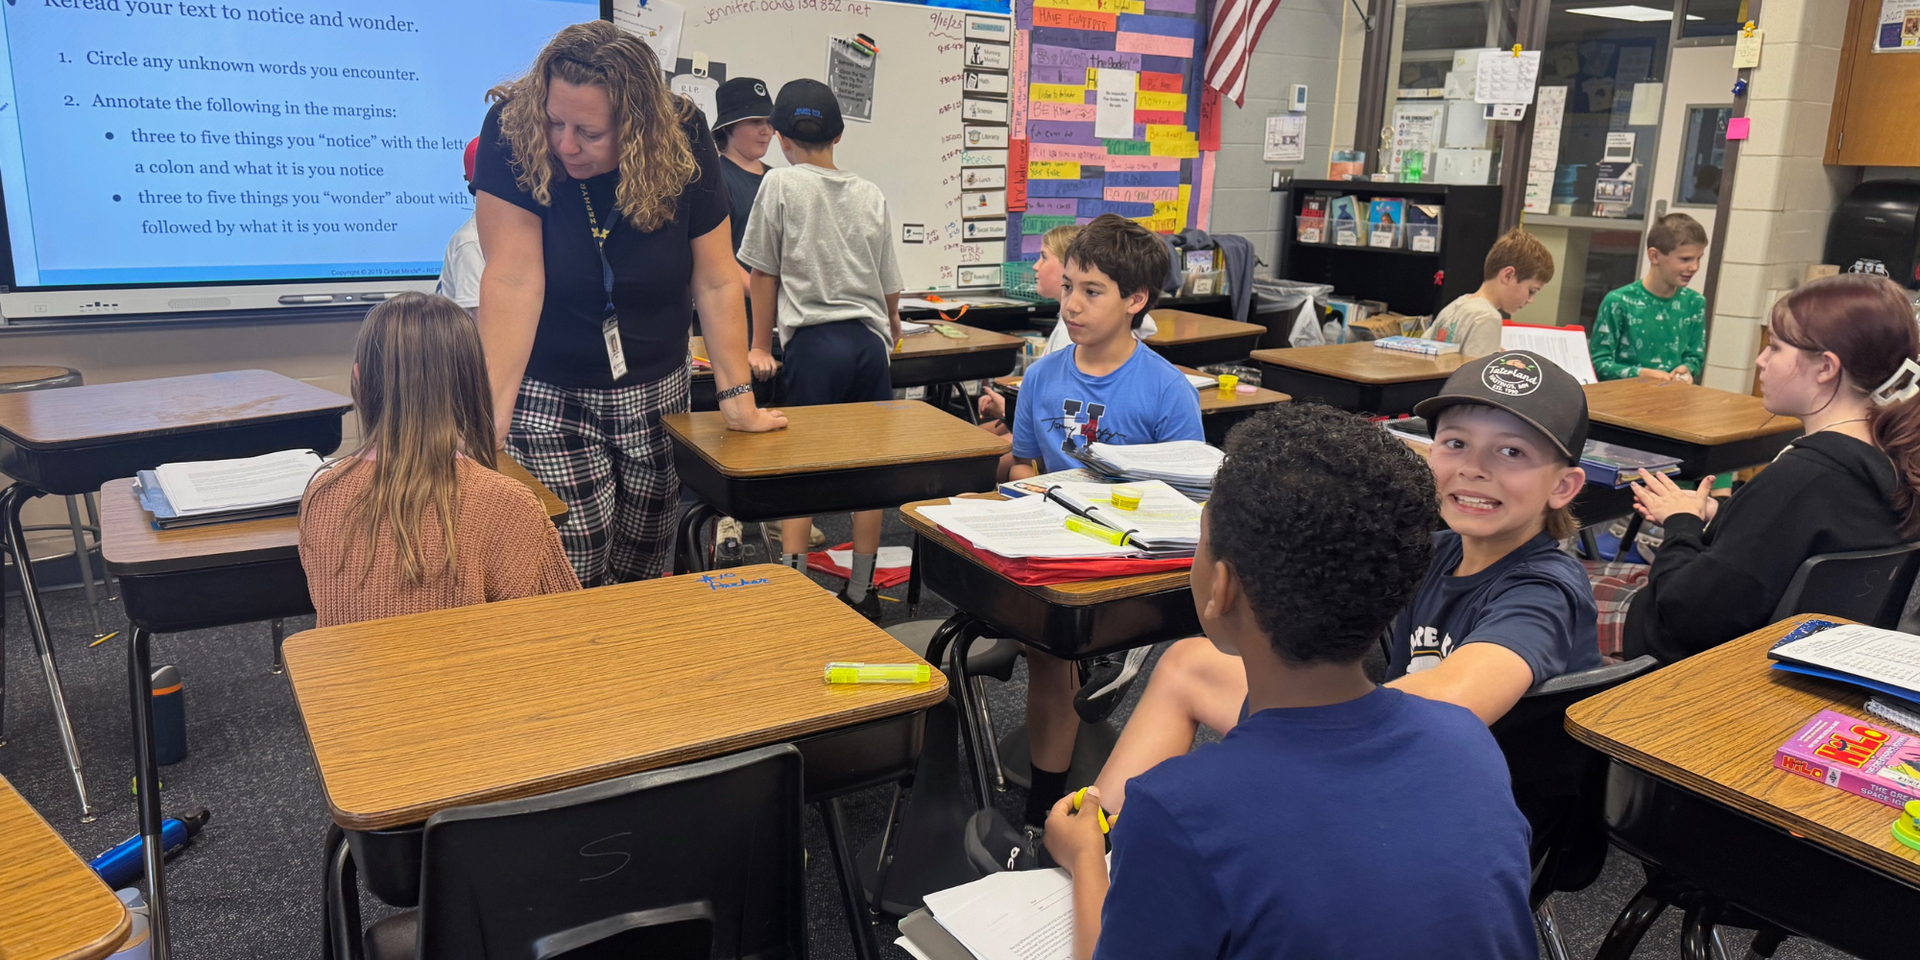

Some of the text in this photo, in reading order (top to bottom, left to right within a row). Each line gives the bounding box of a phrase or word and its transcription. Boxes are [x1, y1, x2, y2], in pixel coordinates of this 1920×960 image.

[126, 0, 173, 17] your
[179, 3, 217, 19] text
[221, 6, 241, 20] to
[247, 7, 305, 25] notice
[310, 11, 344, 28] and
[348, 15, 419, 33] wonder.
[930, 12, 964, 31] 9/16/25
[1039, 8, 1062, 25] HAVE
[58, 50, 420, 81] 1. Circle any unknown words you encounter.
[64, 93, 397, 120] 2. Annotate the following in the margins:
[977, 107, 993, 115] Science
[131, 128, 176, 144] three
[180, 130, 197, 144] to
[201, 130, 231, 145] five
[235, 131, 284, 149] things
[287, 135, 315, 149] you
[381, 135, 412, 149] with
[416, 136, 439, 150] the
[981, 133, 1000, 142] Literacy
[961, 150, 992, 164] Recess
[135, 159, 384, 178] a colon and what it is you notice
[138, 189, 182, 204] three
[186, 191, 203, 204] to
[207, 189, 236, 204] five
[240, 190, 289, 207] things
[292, 193, 320, 207] you
[395, 191, 435, 205] about
[438, 192, 468, 205] with
[1309, 201, 1319, 210] TWO
[142, 218, 398, 236] followed by what it is you wonder
[331, 269, 360, 277] Copyright
[1488, 365, 1538, 385] Taterland
[1860, 787, 1890, 802] SPACE
[1870, 783, 1888, 795] THE
[578, 831, 632, 882] S
